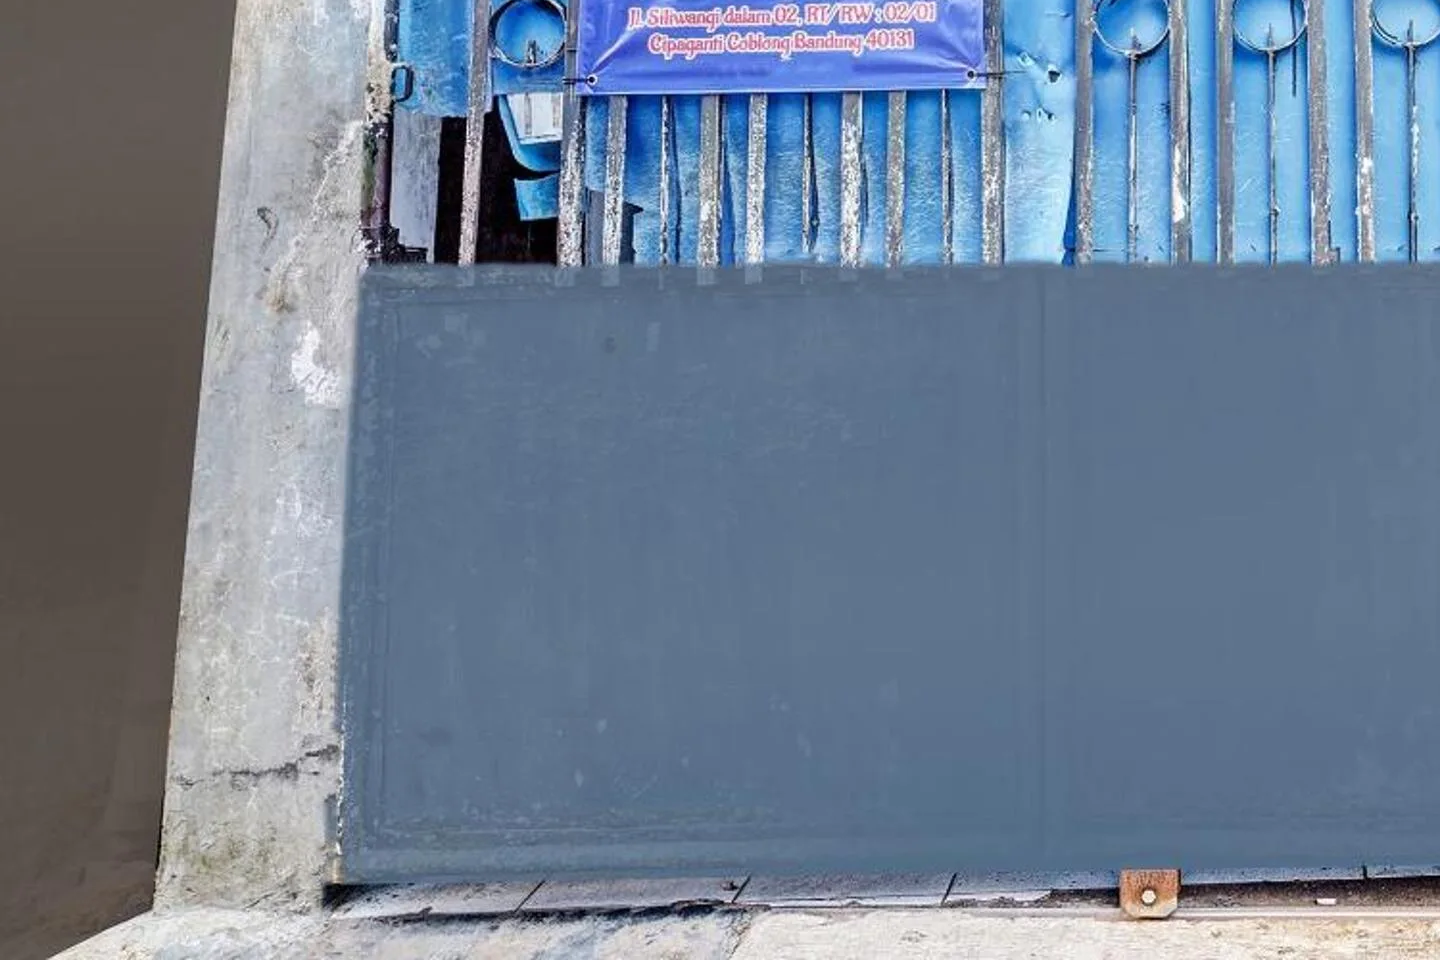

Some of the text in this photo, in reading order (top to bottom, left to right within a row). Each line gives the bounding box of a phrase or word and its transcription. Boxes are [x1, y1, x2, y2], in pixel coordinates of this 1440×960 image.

[647, 6, 722, 32] Siliwangi
[723, 5, 771, 26] dalam
[773, 4, 803, 26] 02,
[883, 2, 937, 24] 02/01
[648, 28, 914, 60] Cipaganti Coblong Bandung 40131
